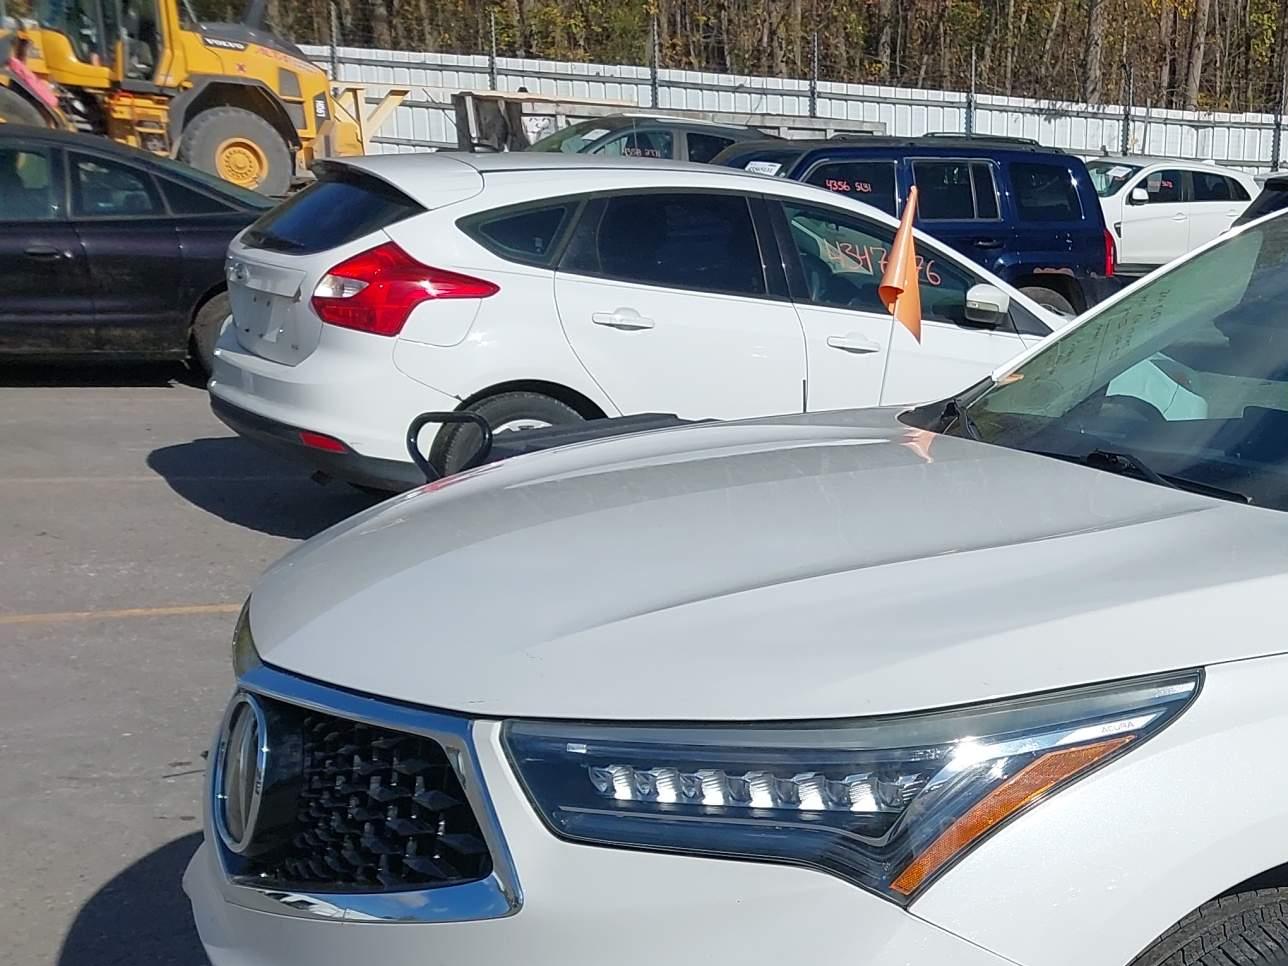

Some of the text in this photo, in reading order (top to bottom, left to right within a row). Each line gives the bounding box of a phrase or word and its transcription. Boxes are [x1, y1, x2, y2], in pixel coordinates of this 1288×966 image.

[204, 37, 245, 50] VOLVO
[825, 178, 851, 192] 4356
[1101, 720, 1135, 734] ACURA
